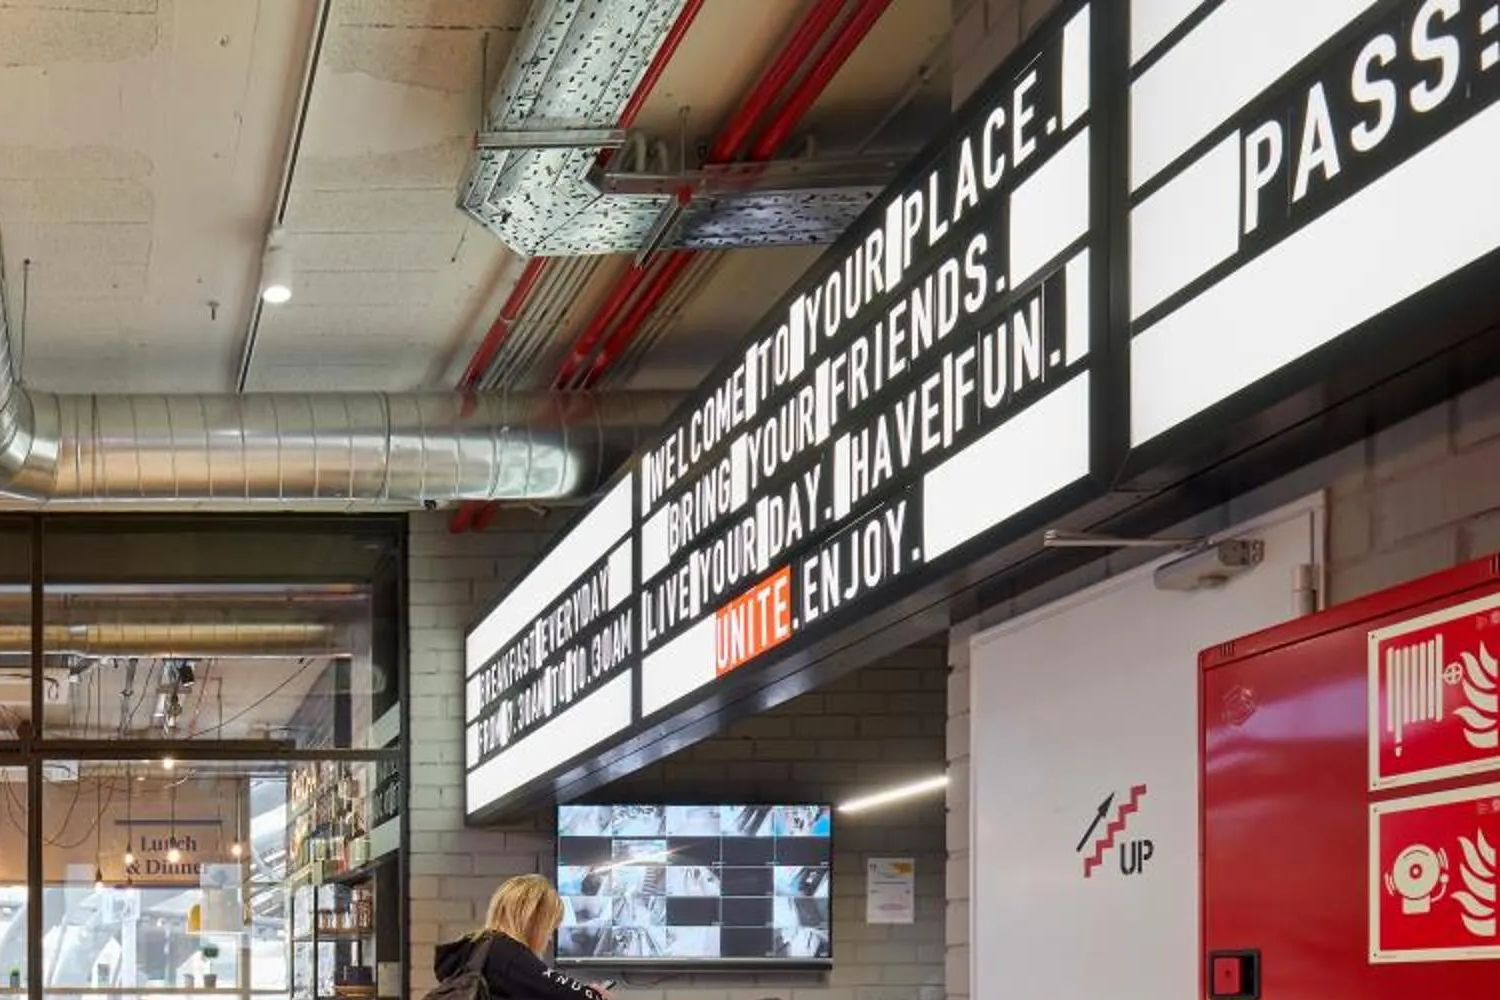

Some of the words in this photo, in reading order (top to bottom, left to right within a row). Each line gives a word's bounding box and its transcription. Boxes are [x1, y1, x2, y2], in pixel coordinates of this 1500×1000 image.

[1243, 0, 1500, 235] PASS:
[650, 362, 744, 502] WELCOME
[758, 323, 789, 401] TO
[806, 228, 884, 355] YOUR
[903, 69, 1057, 270] PLACE.
[669, 457, 731, 559] BRING
[747, 384, 815, 490] YOUR
[831, 232, 1005, 427] FRIENDS.
[647, 564, 689, 644] LIVE
[699, 516, 757, 604] YOUR
[769, 462, 833, 559] DAY.
[851, 372, 941, 503] HAVE
[954, 296, 1061, 433] FUN.
[541, 563, 610, 665] EVERYDAY
[803, 501, 921, 624] ENJOY.
[141, 835, 197, 852] Lunch
[146, 859, 206, 875] Dinne
[1120, 840, 1155, 876] UP
